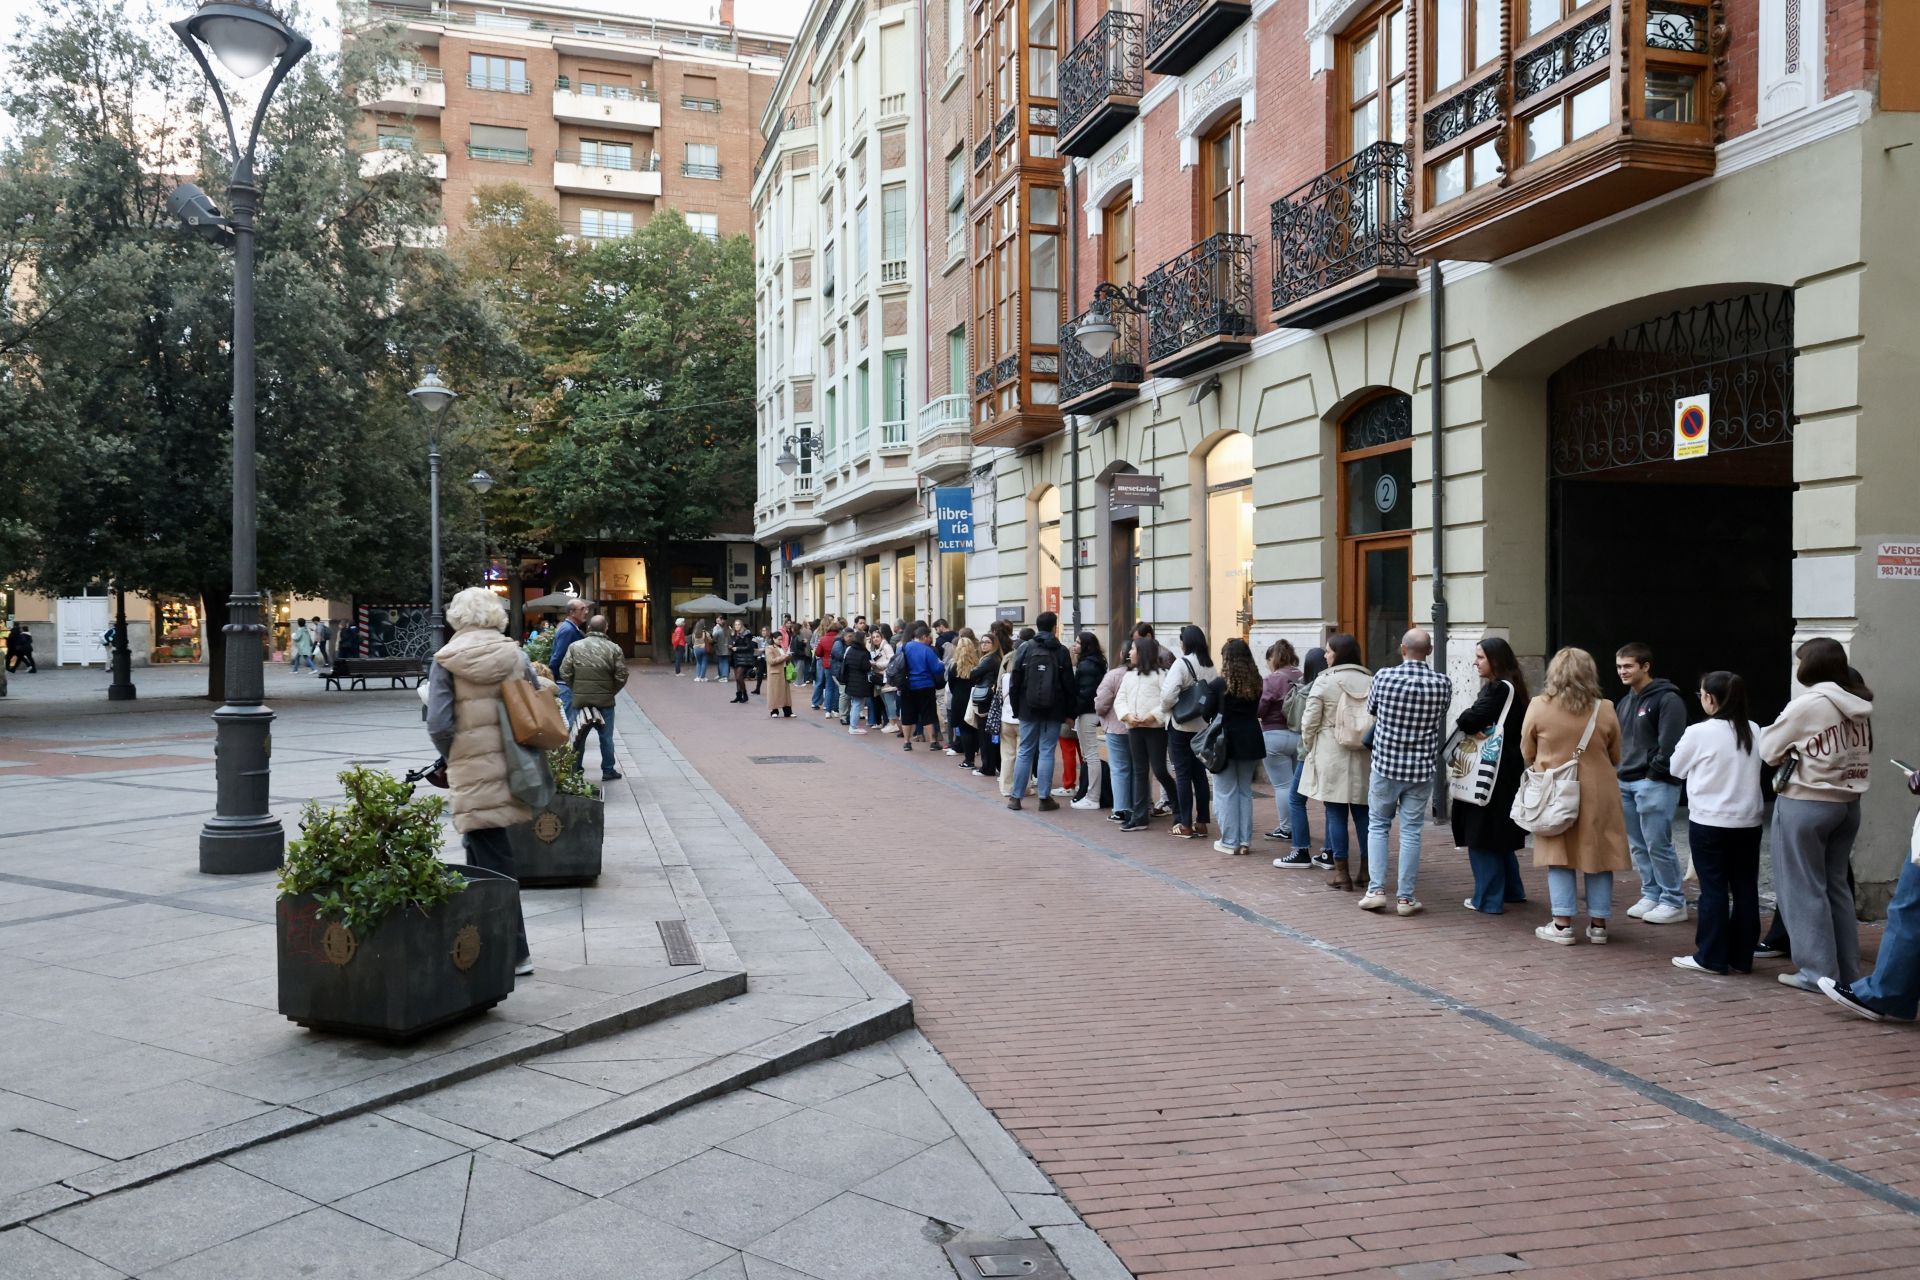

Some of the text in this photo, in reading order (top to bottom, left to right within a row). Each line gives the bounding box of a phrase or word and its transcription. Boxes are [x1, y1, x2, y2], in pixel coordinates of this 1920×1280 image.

[1382, 482, 1390, 501] 2
[938, 507, 973, 520] libre-
[951, 521, 969, 534] ría
